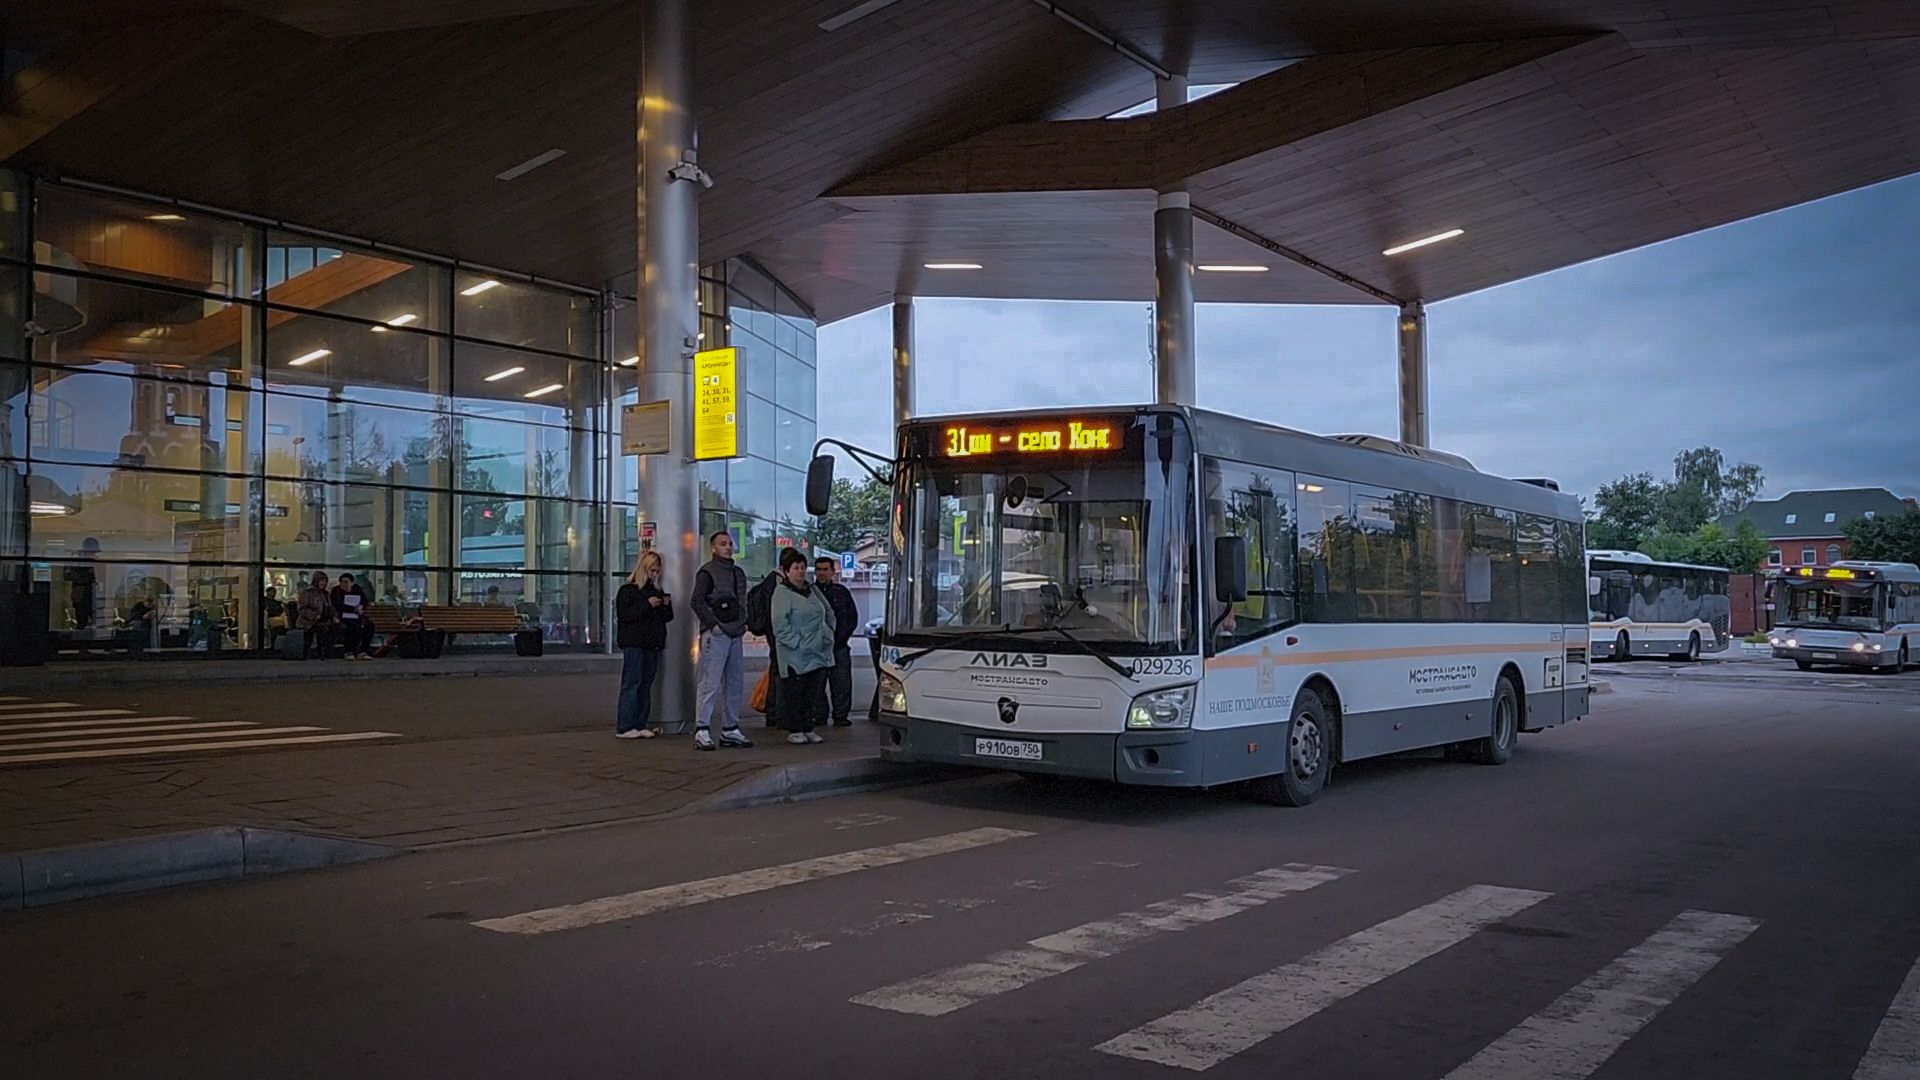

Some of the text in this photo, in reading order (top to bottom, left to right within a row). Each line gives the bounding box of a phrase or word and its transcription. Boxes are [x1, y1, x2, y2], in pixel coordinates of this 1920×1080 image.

[1018, 431, 1061, 451] село
[844, 554, 852, 567] P
[970, 652, 1048, 668] ЛИАЗ
[1132, 658, 1193, 675] 029236
[970, 674, 1048, 686] МОСТРАНСАВТО
[1409, 665, 1477, 684] МОСТРАНСАВТО
[1209, 695, 1291, 714] НАШЕ ПОДМОСКОВЬЕ
[1022, 743, 1040, 754] 750
